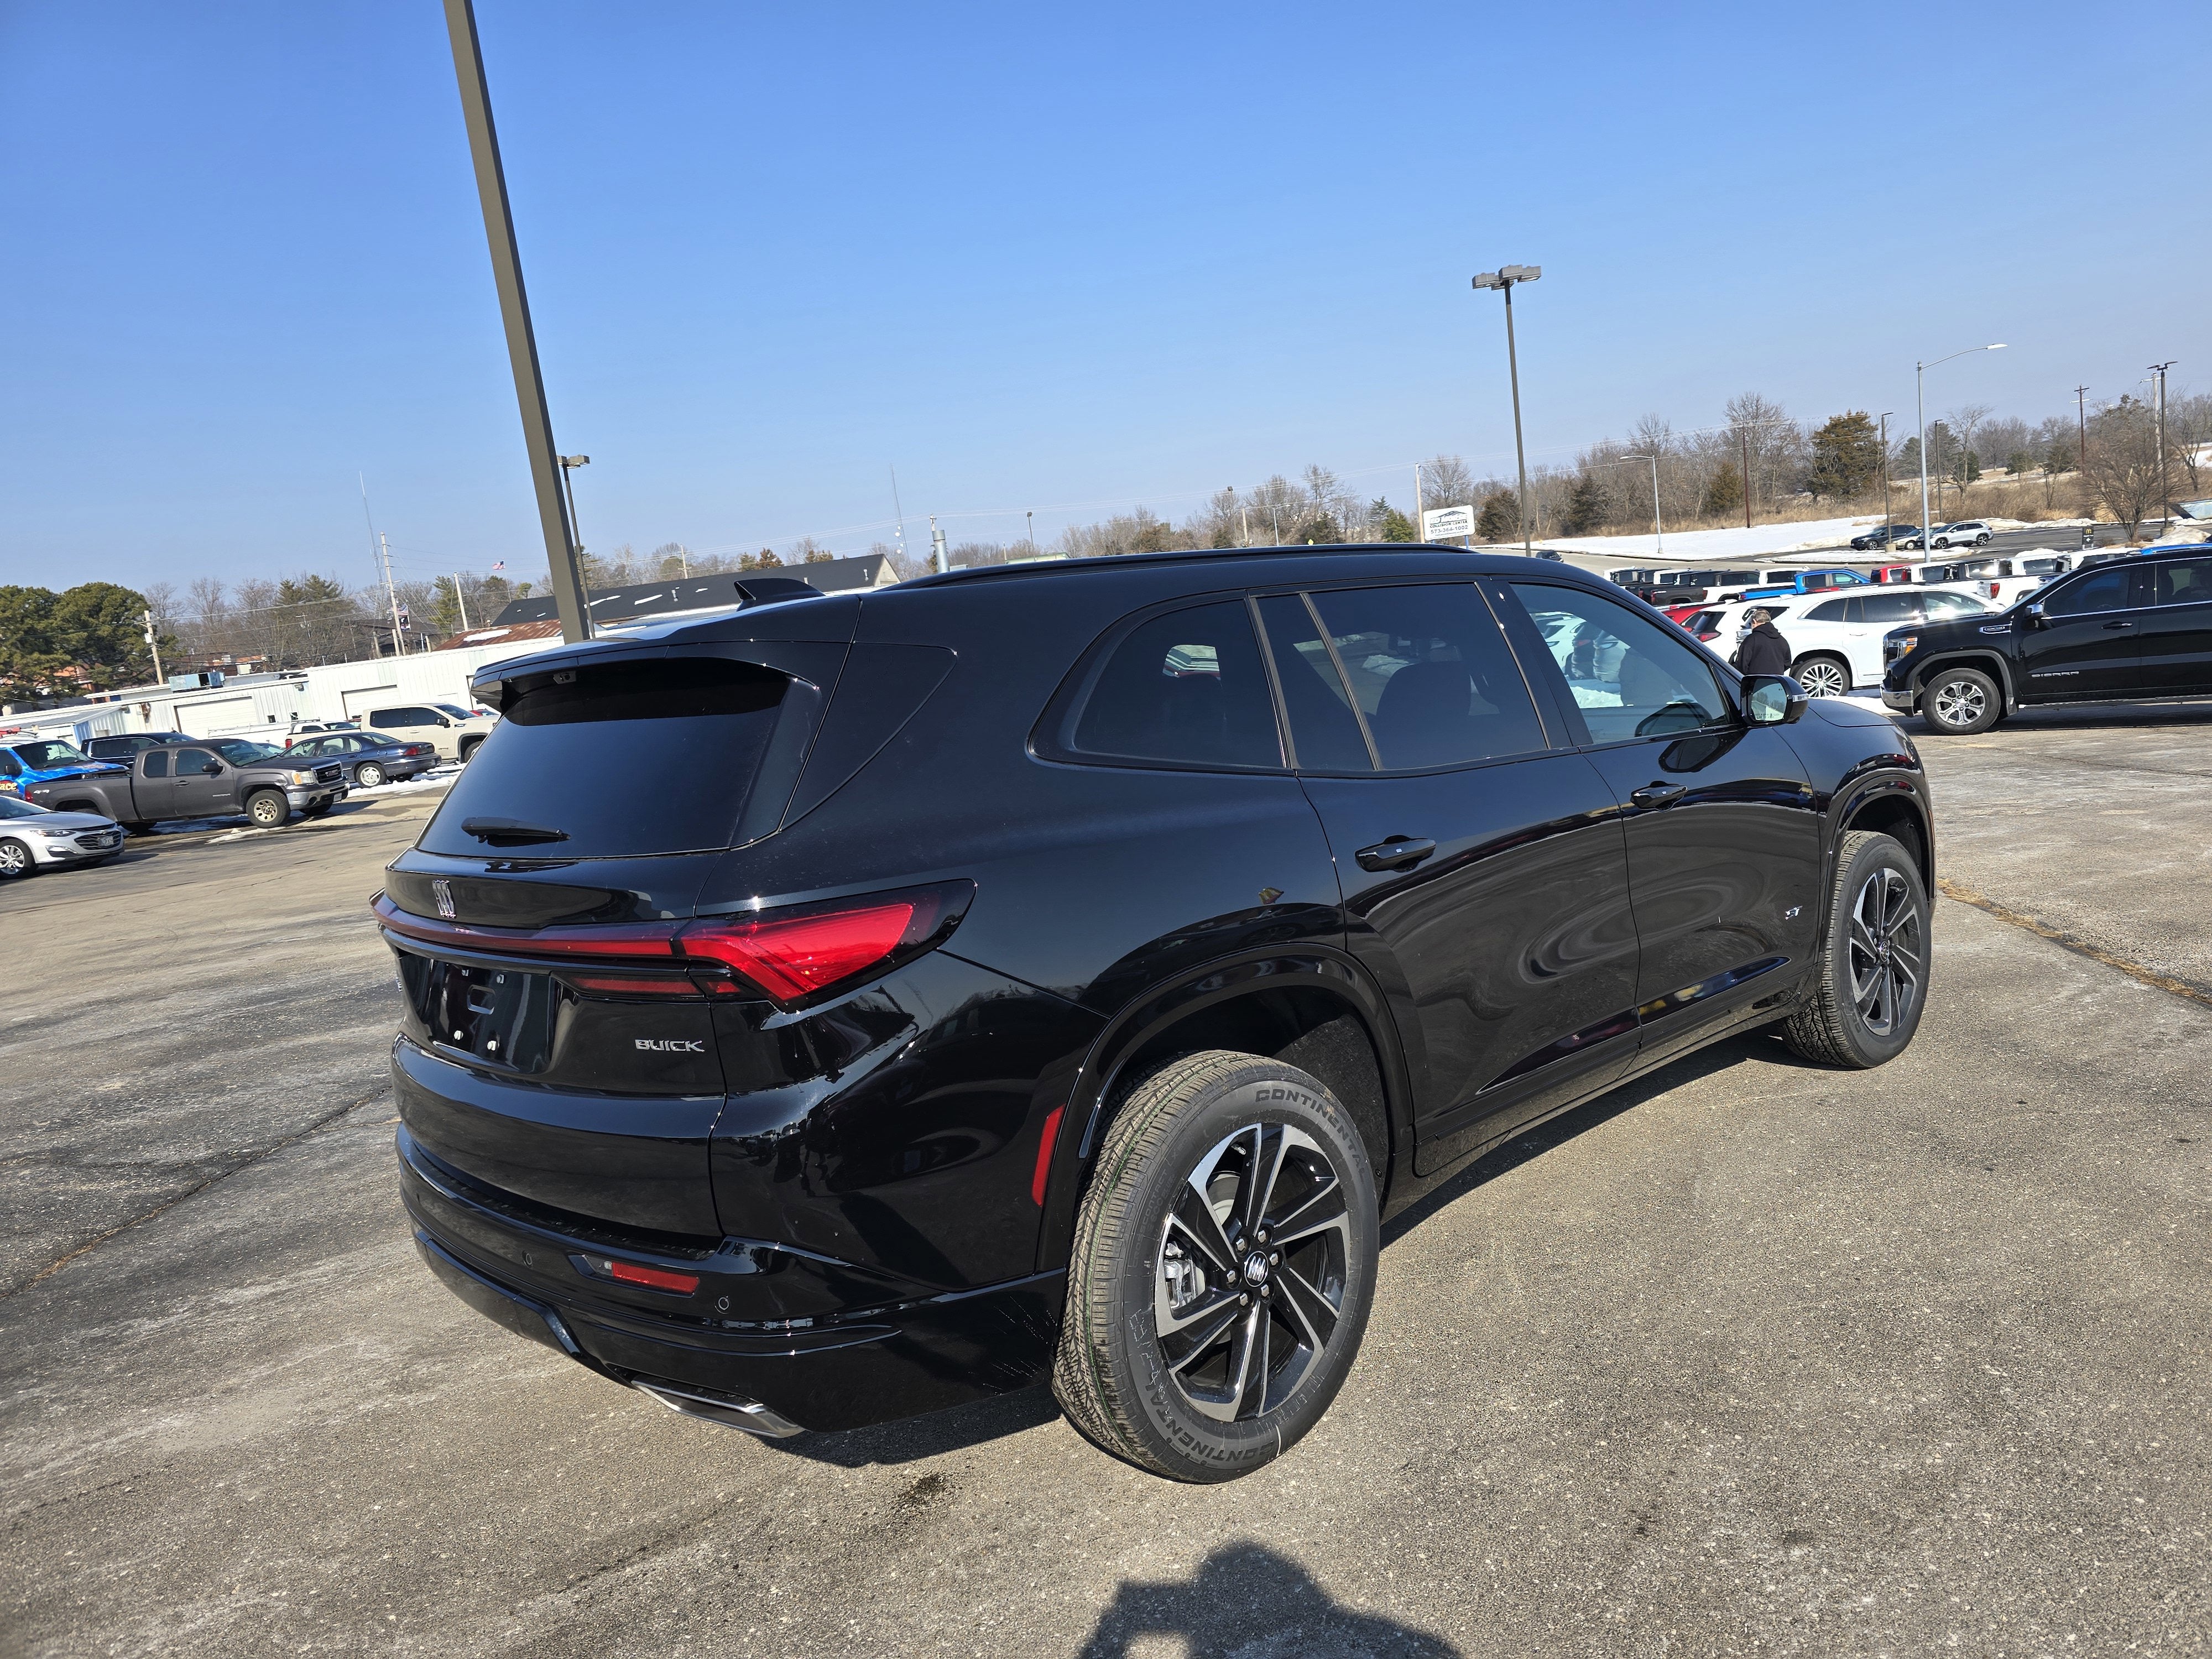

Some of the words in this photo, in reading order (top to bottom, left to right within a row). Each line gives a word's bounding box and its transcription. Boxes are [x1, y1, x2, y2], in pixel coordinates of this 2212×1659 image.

[635, 1039, 705, 1052] BUICK
[1255, 1088, 1365, 1185] CONTINENTAL
[1145, 1374, 1274, 1462] CONTINENTAL
